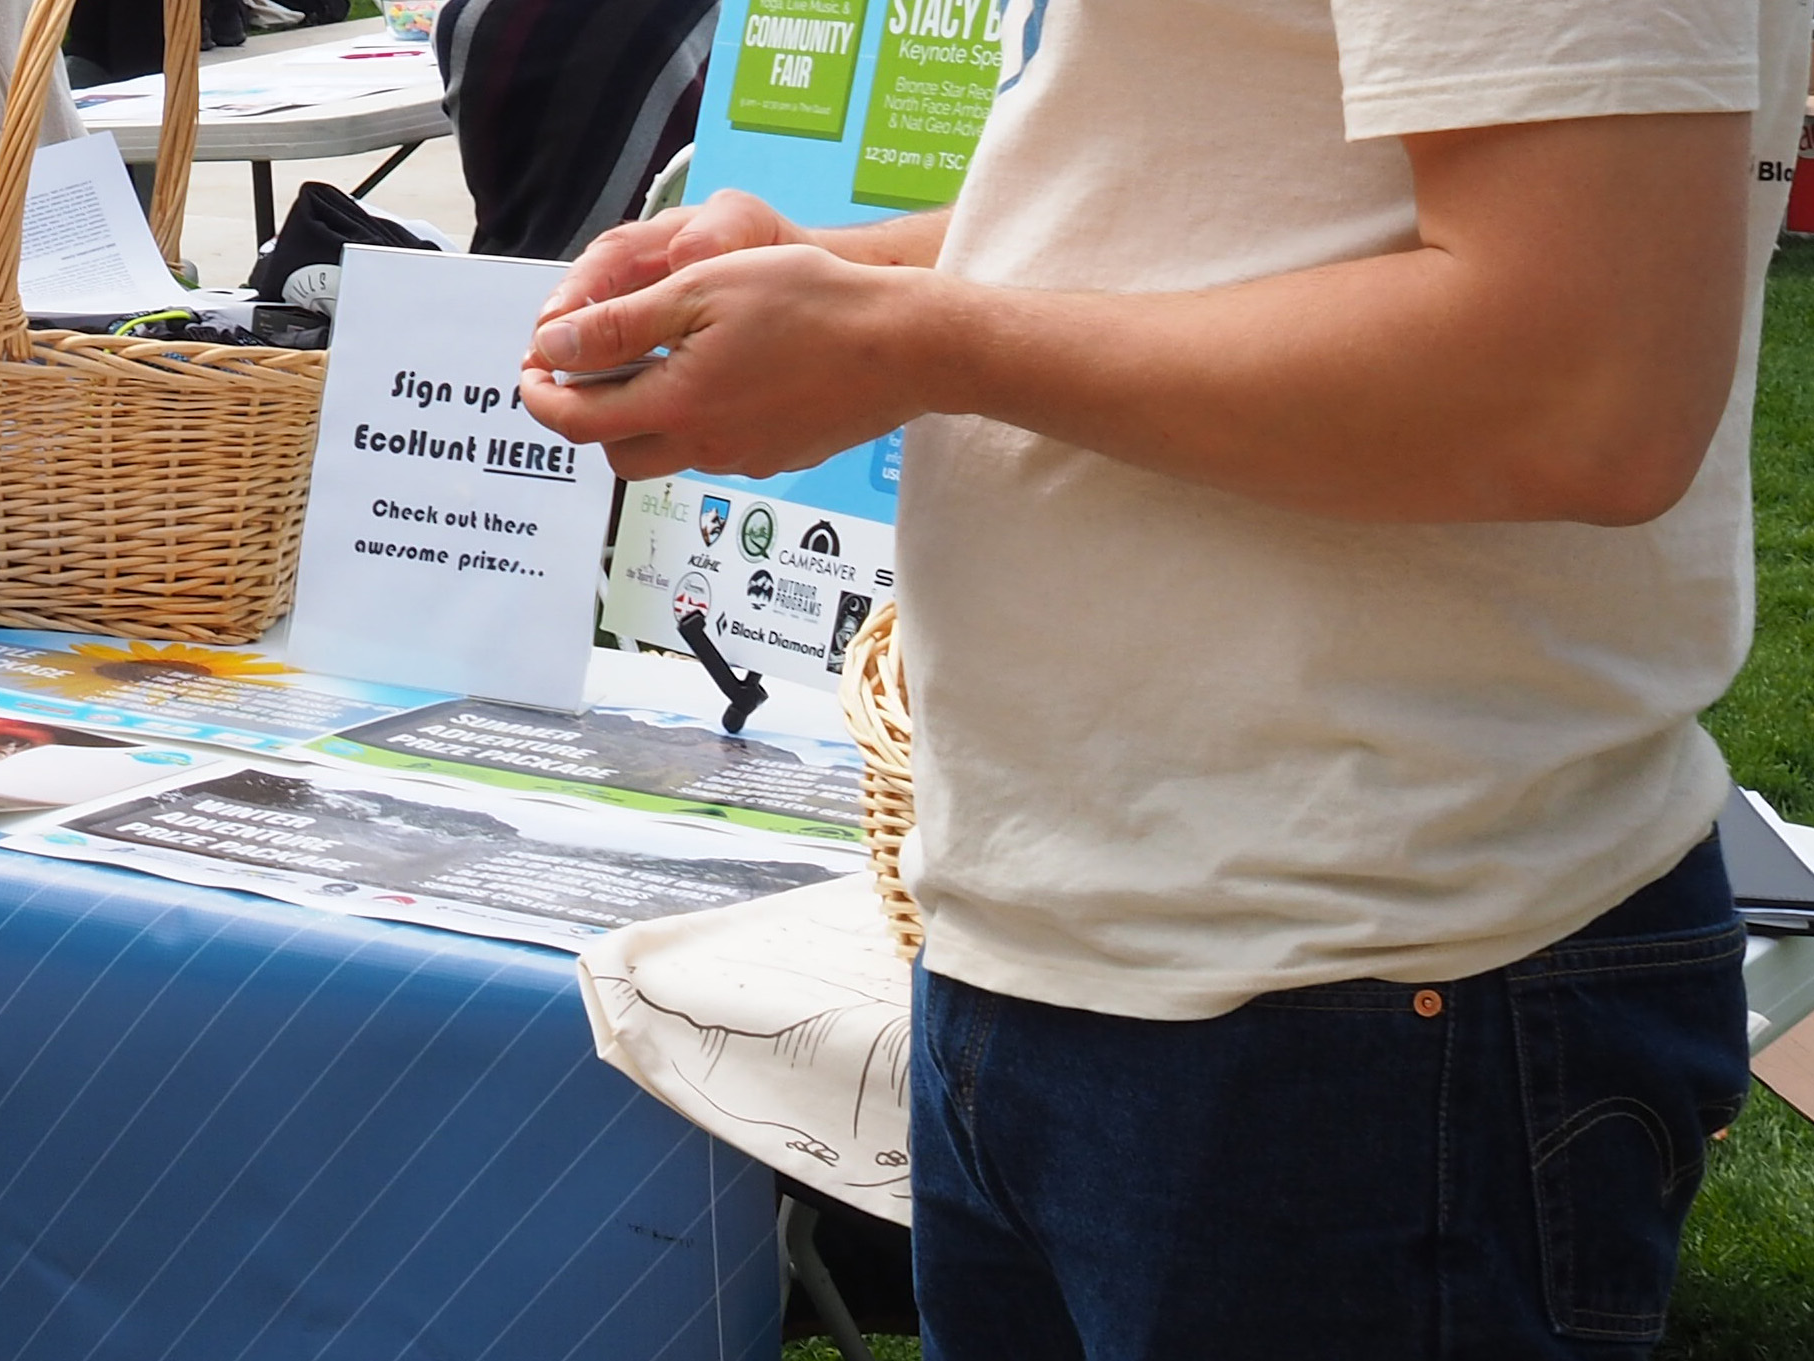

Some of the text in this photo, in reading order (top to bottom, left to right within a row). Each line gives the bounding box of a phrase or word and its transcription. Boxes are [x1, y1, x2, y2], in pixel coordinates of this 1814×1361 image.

[745, 15, 854, 54] COMMUNITY
[899, 40, 966, 66] Keynote
[770, 54, 813, 88] FAIR
[895, 77, 939, 93] Bronze
[941, 80, 966, 96] Star
[885, 94, 920, 112] North
[922, 97, 950, 115] Face
[889, 113, 897, 127] &
[901, 115, 921, 130] Nat
[925, 119, 950, 133] Geo
[898, 153, 920, 167] pm
[391, 371, 452, 408] Sign
[465, 384, 500, 413] up
[354, 424, 576, 479] EcoHunt HERE!
[372, 499, 538, 537] Check out these
[355, 539, 544, 578] awesome prizes...
[779, 550, 857, 582] CAMPSAVER
[775, 592, 822, 617] PROGRAMS
[731, 621, 826, 658] Black Diamond
[416, 725, 598, 759] ADVENTURE
[449, 713, 584, 741] SUMMER
[386, 733, 620, 780] PRIZE PACKAGE
[192, 799, 316, 829] WINTER
[116, 822, 362, 872] PRIZE PACKAGE
[152, 811, 344, 852] ADVENTURE
